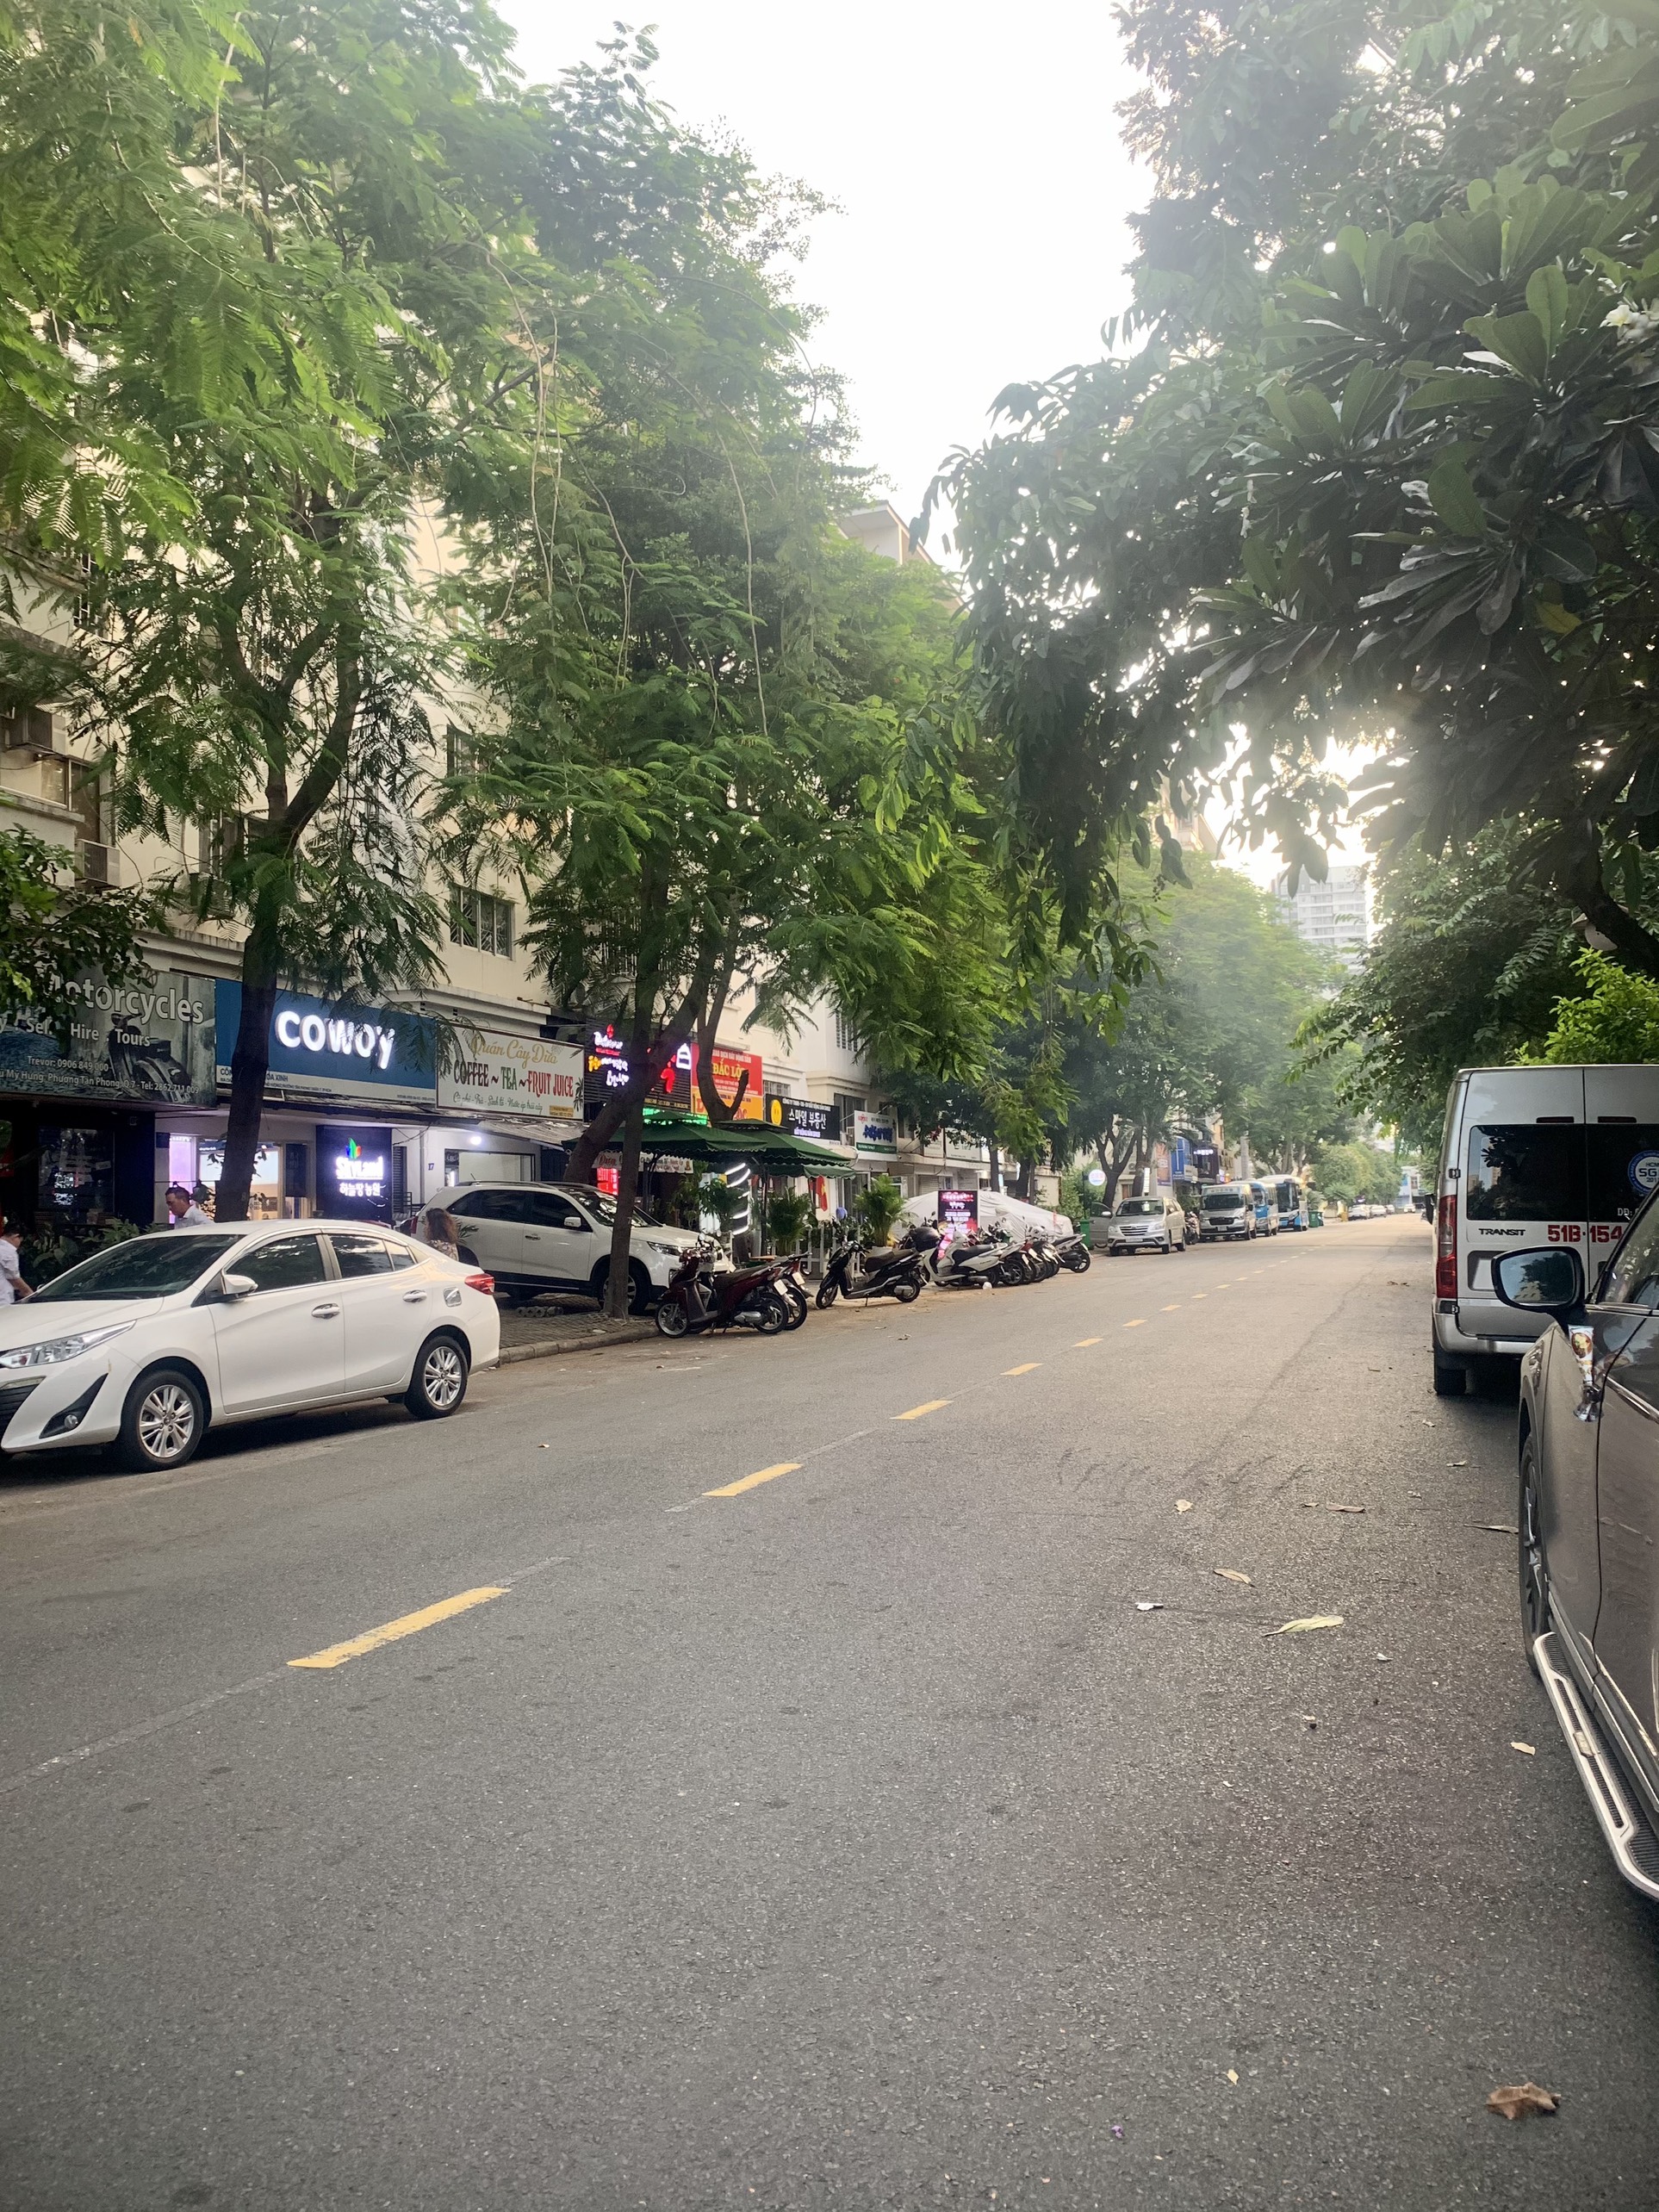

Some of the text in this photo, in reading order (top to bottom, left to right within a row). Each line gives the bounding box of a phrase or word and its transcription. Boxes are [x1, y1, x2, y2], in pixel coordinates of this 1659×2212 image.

[26, 1016, 53, 1035] Sel
[71, 1022, 99, 1041] Hire
[115, 1028, 151, 1047] Tours
[28, 1055, 109, 1072] Trevor: 0906 849 000
[506, 1039, 531, 1070] Cây
[140, 1081, 153, 1090] Tel:
[154, 1082, 171, 1091] 2862
[186, 1085, 200, 1094] 009
[454, 1059, 574, 1098] COFFEE TEA FRUIT JUICE
[788, 1108, 827, 1129] 스마일 부동산
[1639, 1168, 1659, 1177] SG
